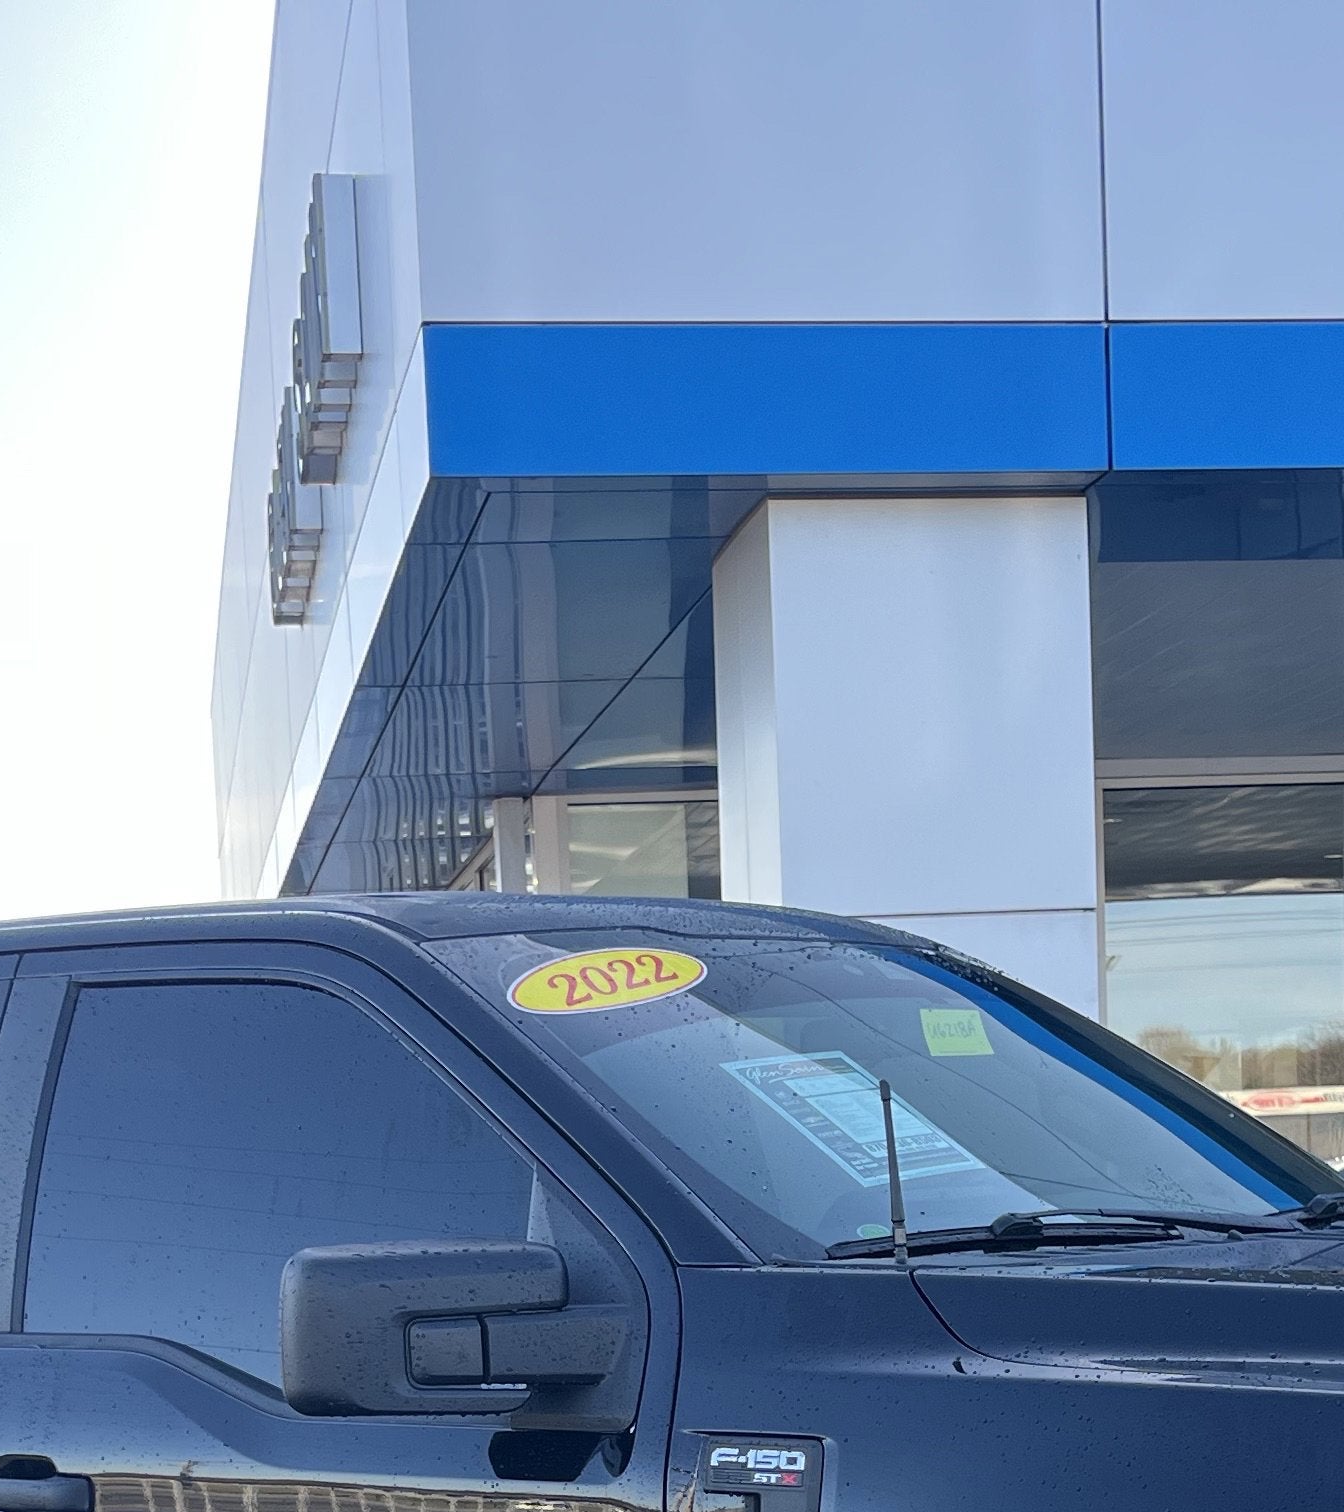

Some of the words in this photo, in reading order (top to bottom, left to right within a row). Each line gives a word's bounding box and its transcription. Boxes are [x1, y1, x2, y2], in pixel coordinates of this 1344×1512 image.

[546, 953, 679, 1007] 2022
[710, 1447, 806, 1471] F-150
[752, 1473, 798, 1486] STX
